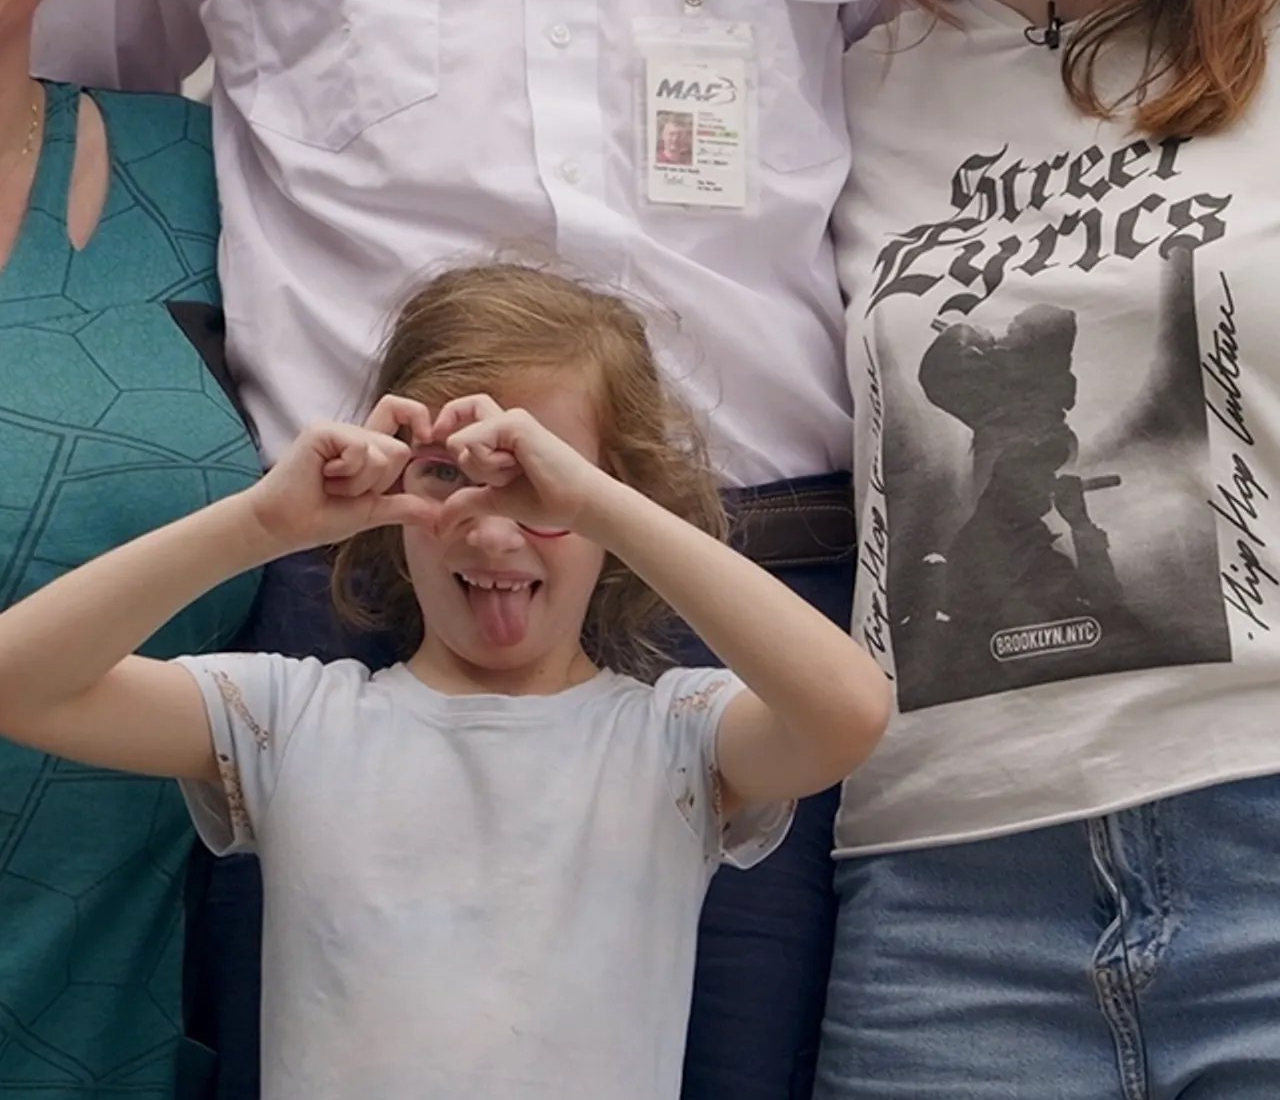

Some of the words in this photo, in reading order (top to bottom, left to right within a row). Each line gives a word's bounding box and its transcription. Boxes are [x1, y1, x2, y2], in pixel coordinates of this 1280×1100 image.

[656, 77, 723, 102] MAF
[950, 136, 1194, 221] Street
[865, 192, 1234, 319] Lyrics
